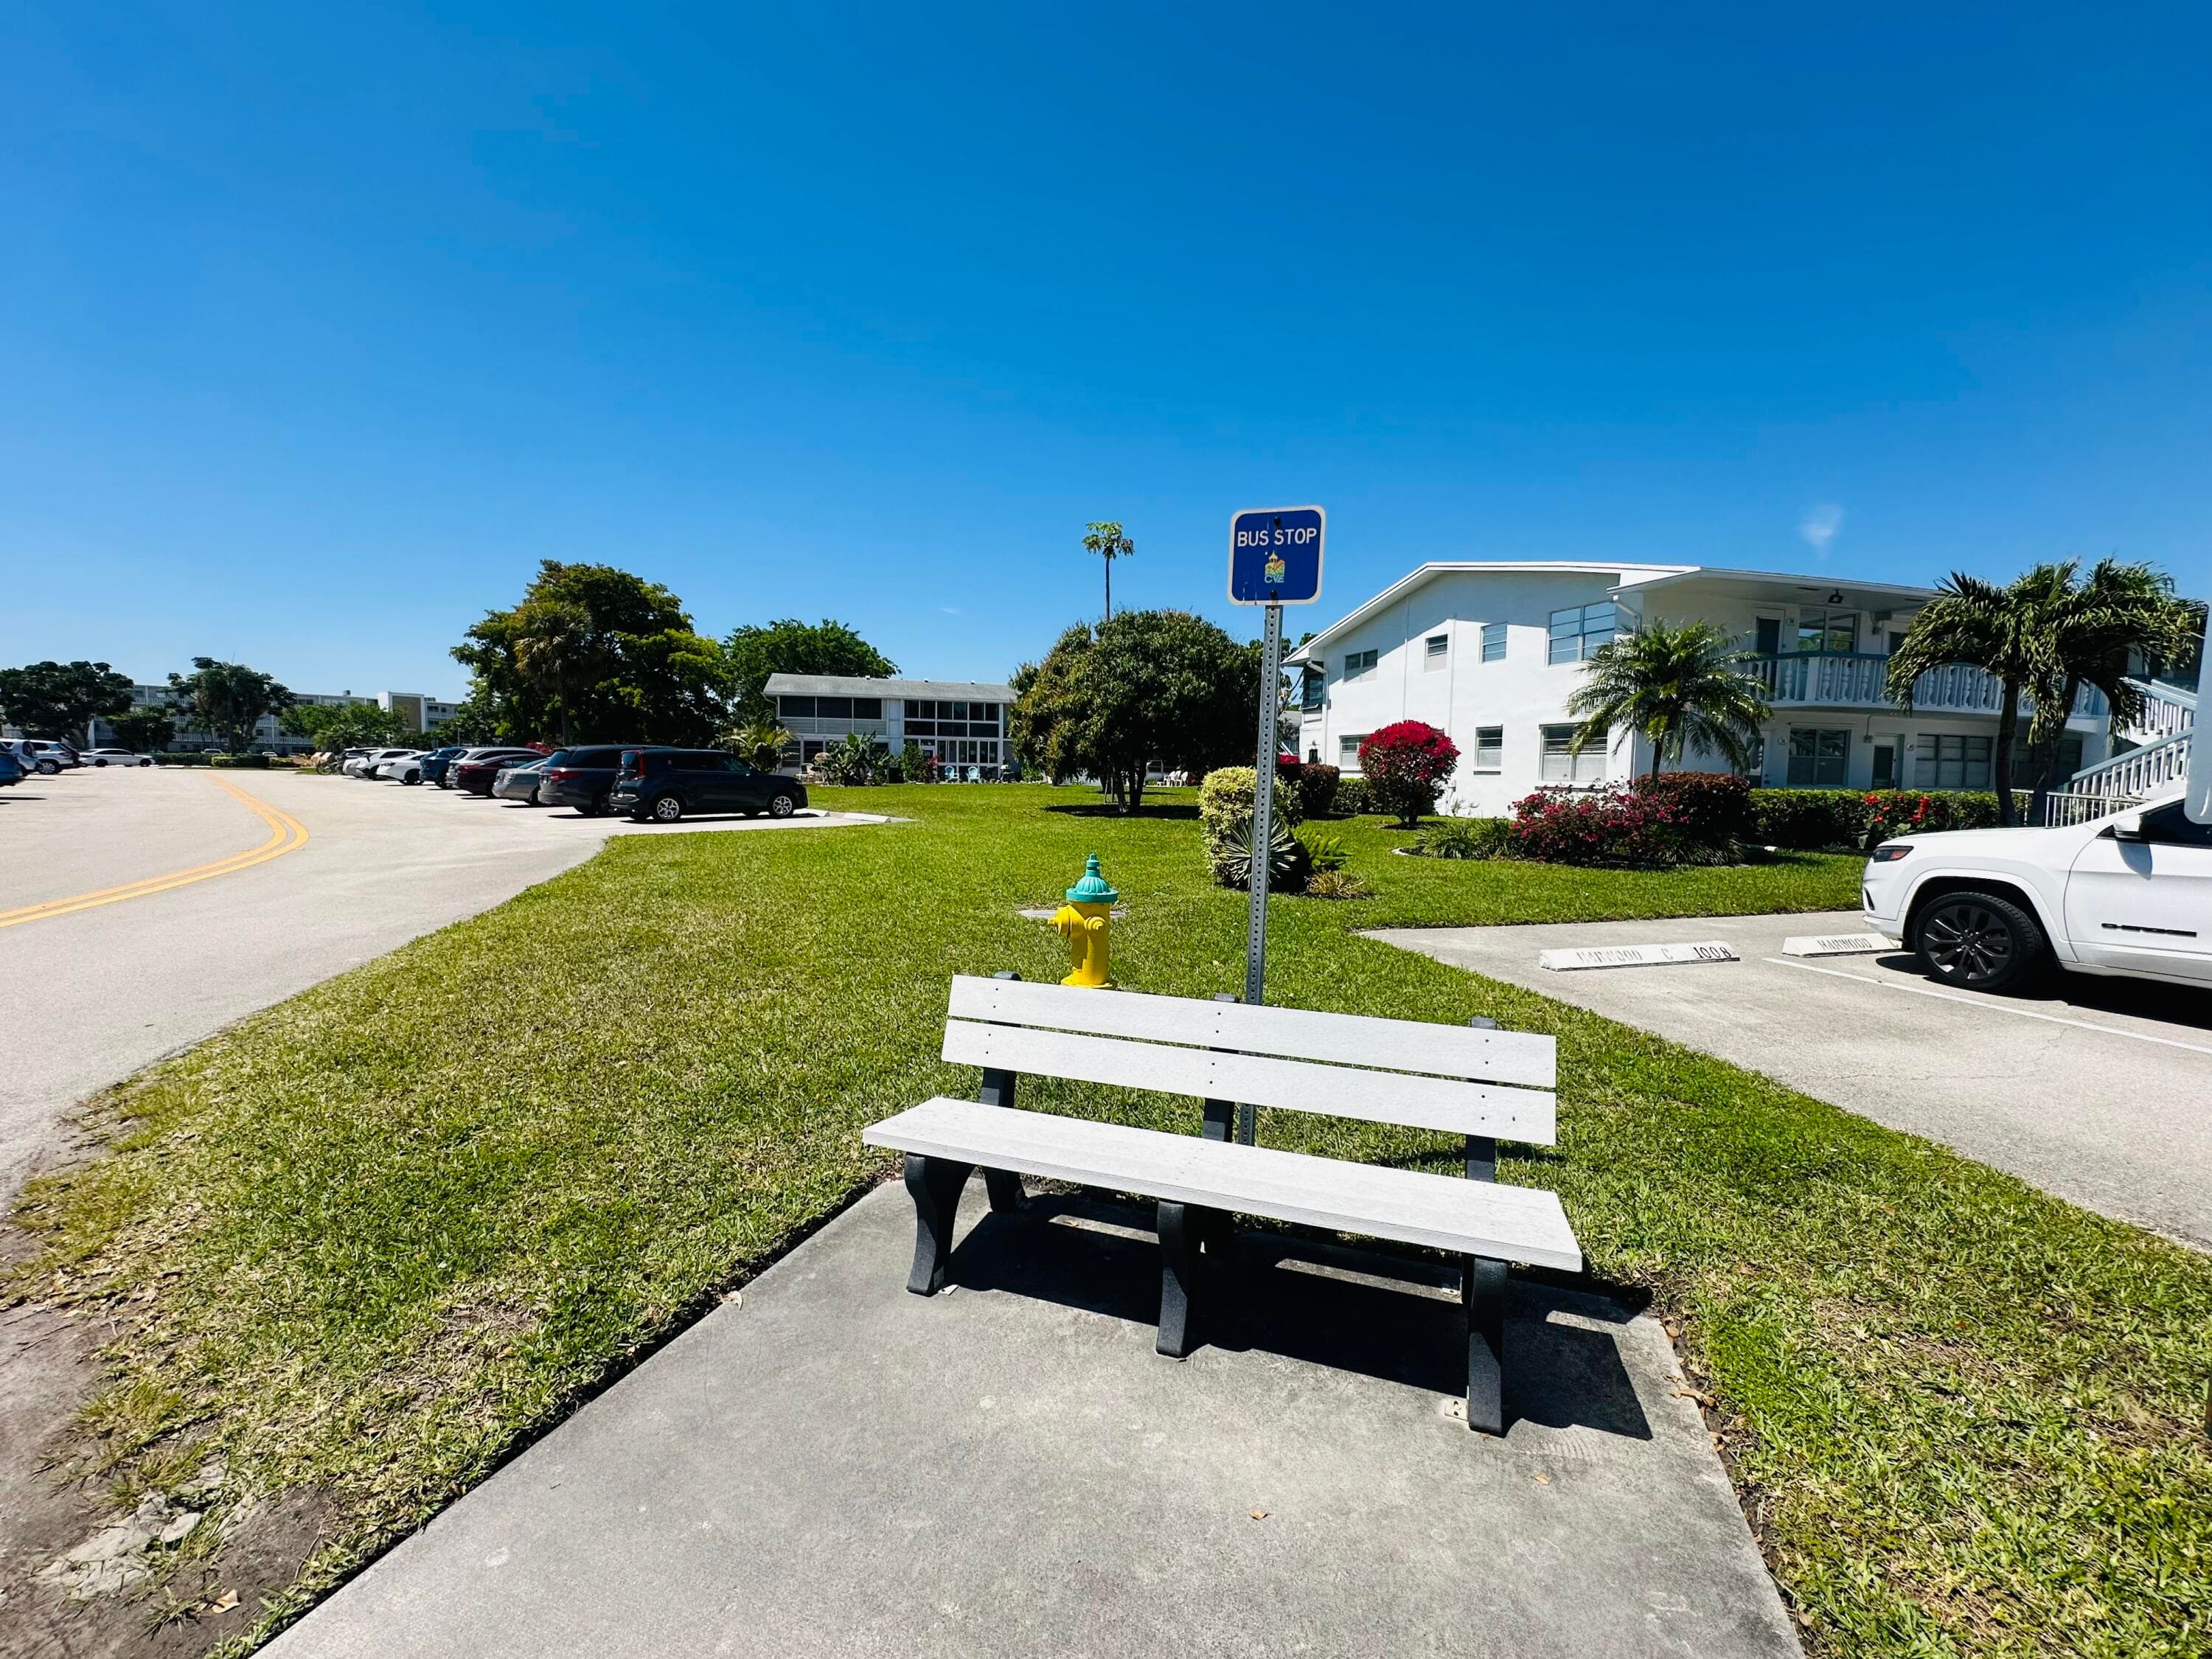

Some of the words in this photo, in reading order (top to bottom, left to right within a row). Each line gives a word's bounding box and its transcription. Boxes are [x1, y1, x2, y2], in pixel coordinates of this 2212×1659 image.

[1237, 530, 1269, 547] BUS
[1273, 528, 1317, 546] STOP
[1264, 574, 1284, 584] CVE
[1817, 937, 1873, 950] HARWOOD
[1660, 947, 1674, 960] C
[1693, 946, 1732, 959] 1008
